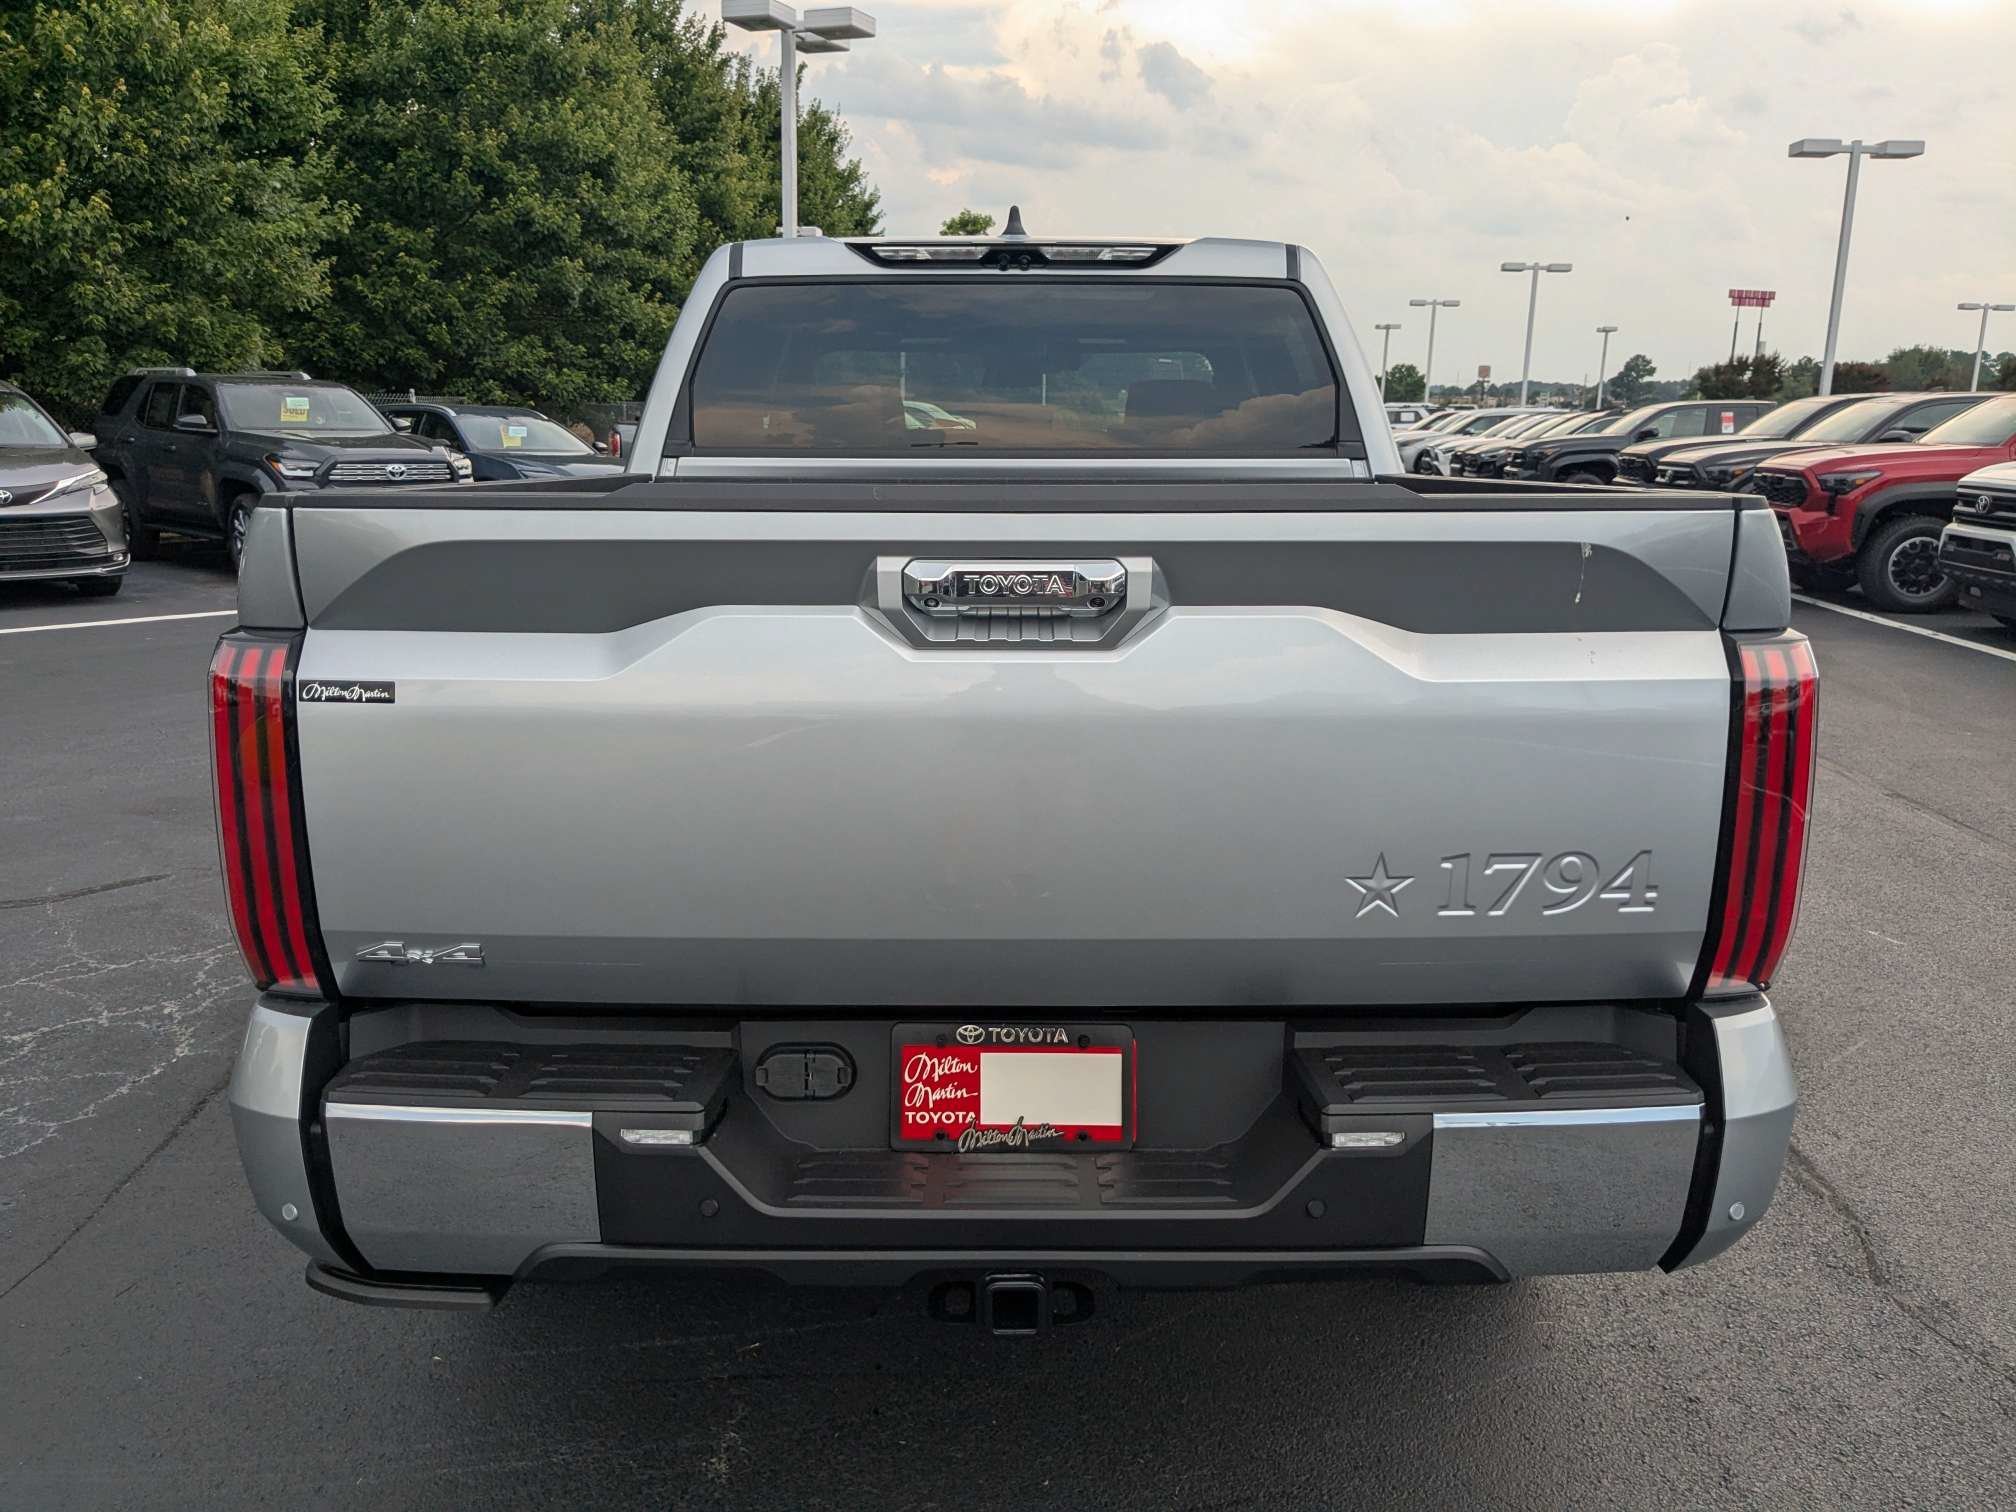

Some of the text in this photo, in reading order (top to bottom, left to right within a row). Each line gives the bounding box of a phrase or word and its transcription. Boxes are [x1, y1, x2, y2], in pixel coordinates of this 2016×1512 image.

[963, 574, 1066, 595] TOYOTA
[302, 682, 390, 701] Milton Martin
[1437, 849, 1659, 917] 1794
[988, 1026, 1069, 1044] TOYOTA
[904, 1052, 978, 1083] Milton
[905, 1081, 978, 1109] Martin
[905, 1111, 977, 1125] TOYOTA
[957, 1115, 1064, 1153] Milton Martin
